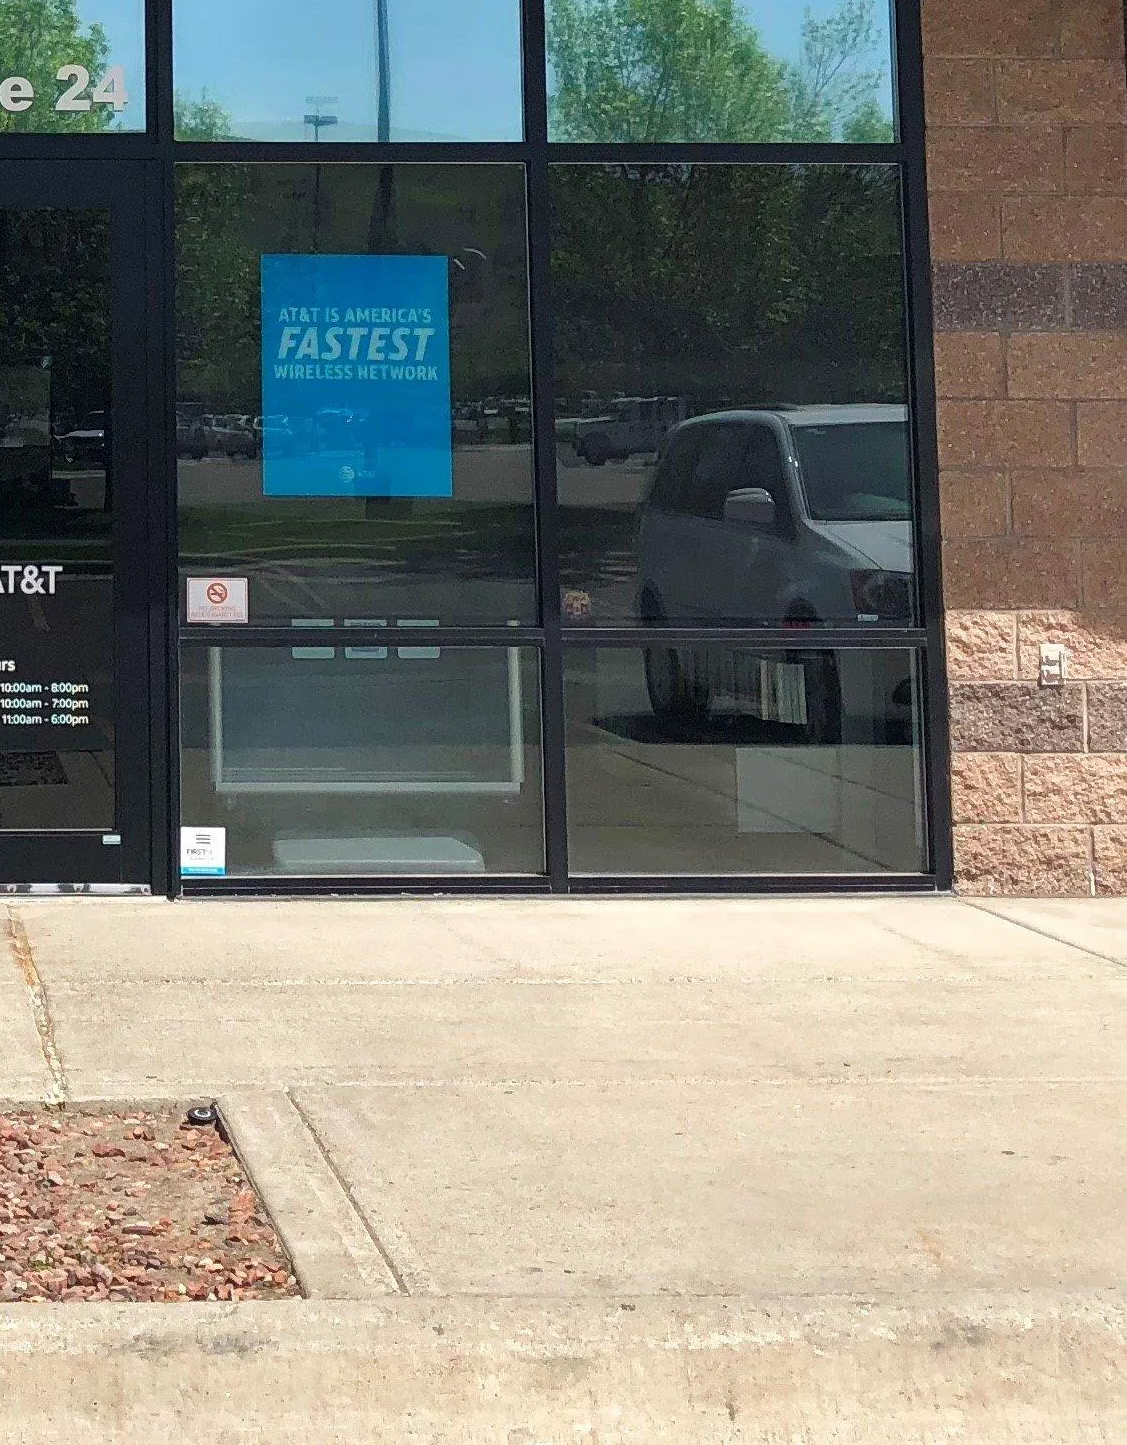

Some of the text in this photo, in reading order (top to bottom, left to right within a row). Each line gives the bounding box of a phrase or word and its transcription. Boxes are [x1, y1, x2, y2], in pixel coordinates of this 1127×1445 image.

[55, 63, 129, 112] 24
[278, 307, 432, 323] AT&T IS AMERICA'S
[277, 326, 437, 361] FASTEST
[274, 363, 438, 381] WIRELESS NETWORK
[0, 682, 42, 693] 10:00am
[51, 682, 89, 695] 8:00pm
[0, 698, 42, 709] 10:00am
[51, 698, 89, 711] 7:00pm
[1, 714, 42, 725] 11:00am
[51, 714, 89, 727] 6:00pm
